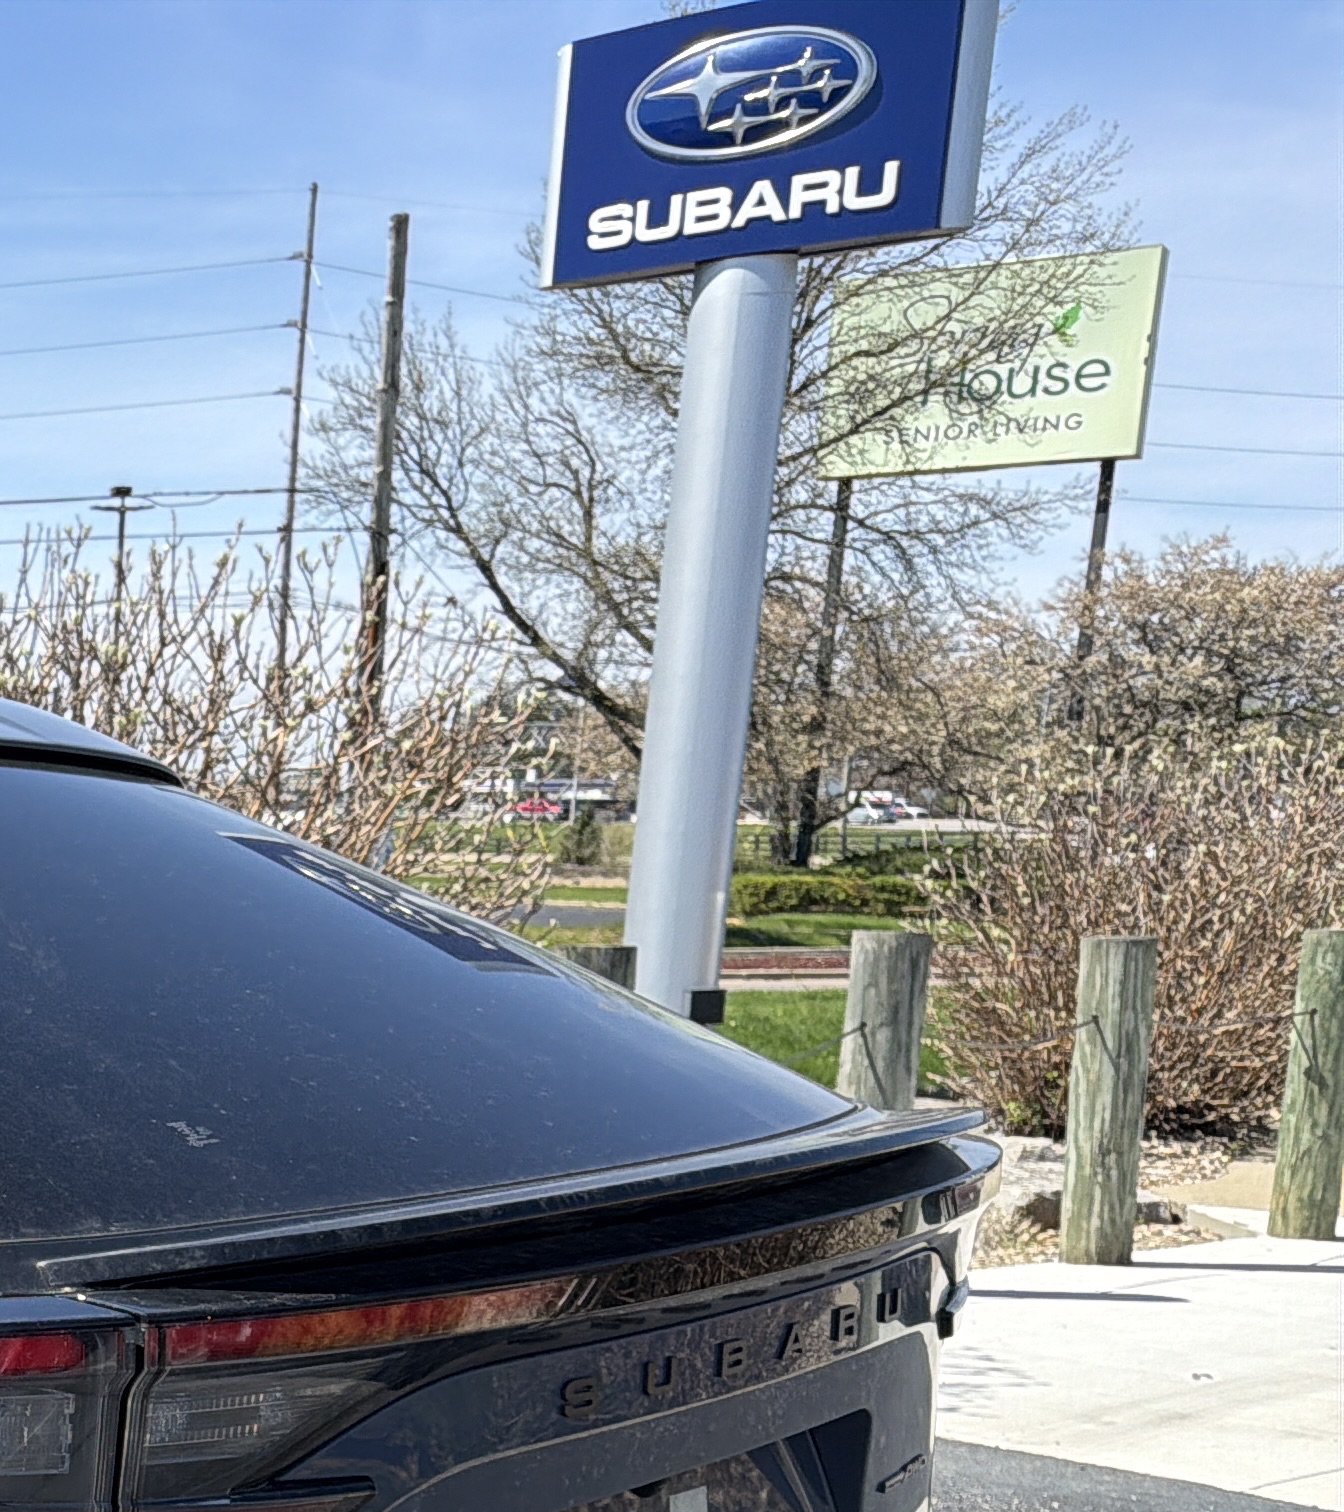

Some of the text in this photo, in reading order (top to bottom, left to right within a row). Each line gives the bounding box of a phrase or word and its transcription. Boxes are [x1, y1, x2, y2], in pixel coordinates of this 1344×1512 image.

[586, 159, 901, 251] SUBARU
[918, 355, 1112, 407] House
[883, 412, 1084, 445] SENIOR LIVING
[561, 1287, 903, 1419] SUBARU
